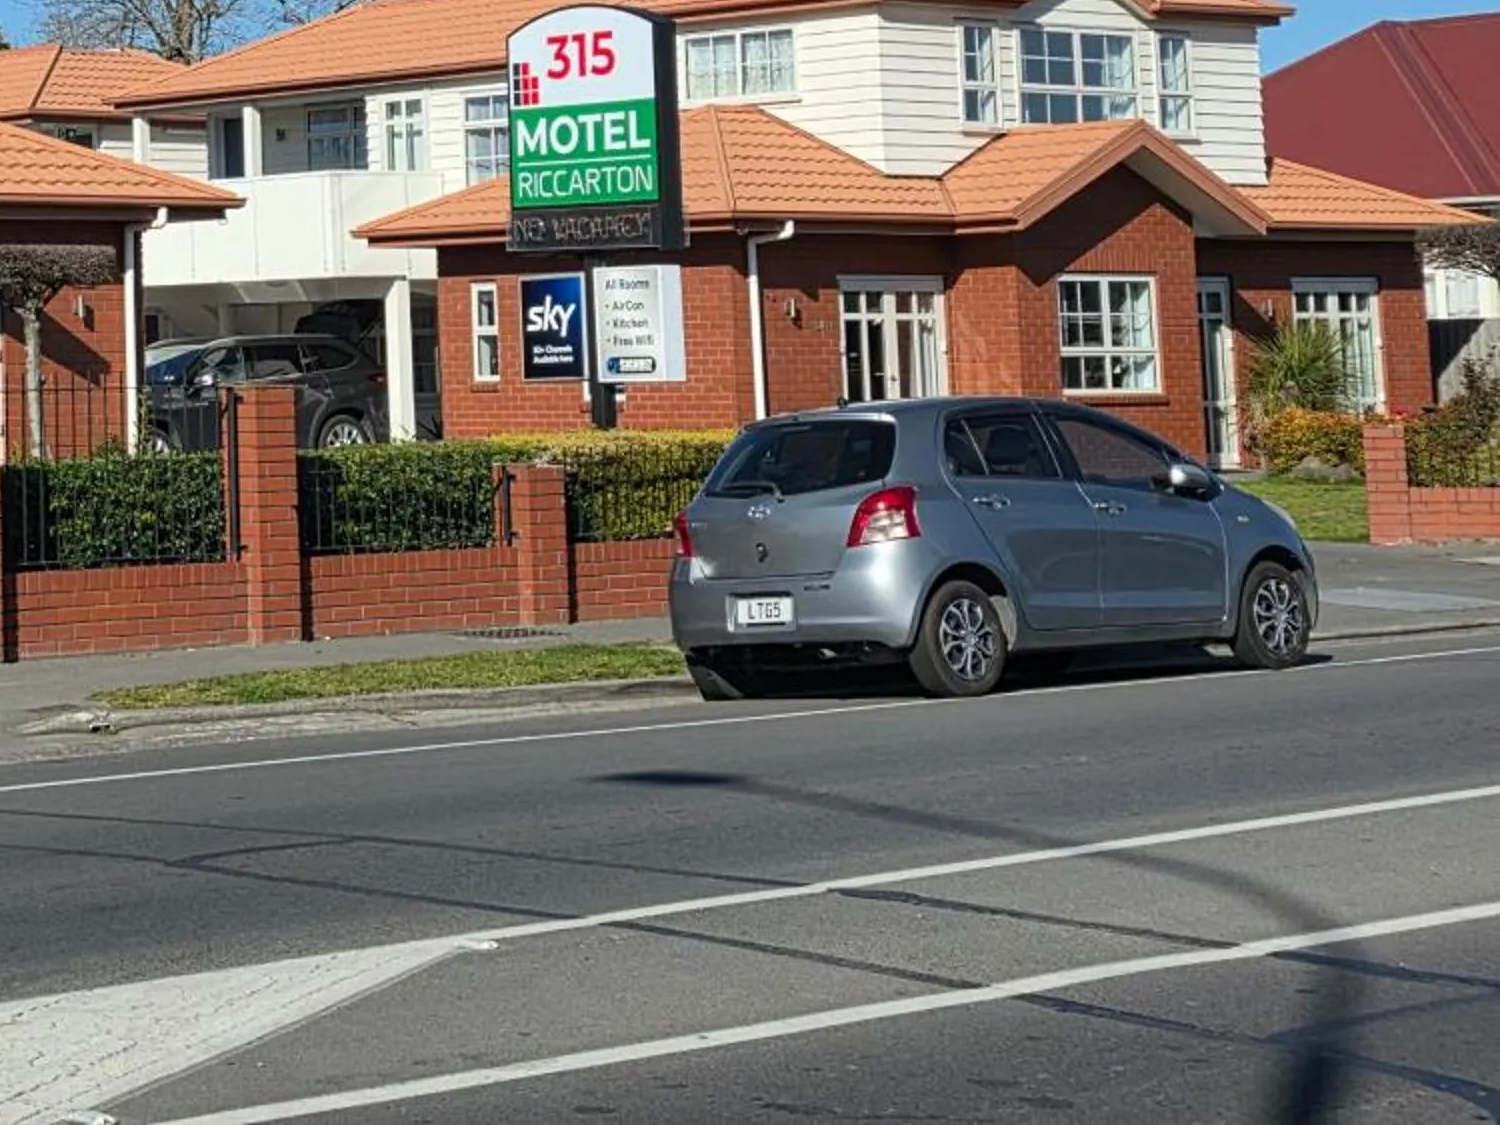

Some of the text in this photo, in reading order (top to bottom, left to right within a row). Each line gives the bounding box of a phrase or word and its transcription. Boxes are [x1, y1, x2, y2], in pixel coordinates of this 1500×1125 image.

[546, 30, 616, 79] 315
[516, 111, 651, 156] MOTEL
[519, 165, 653, 198] RICCARTON
[526, 294, 576, 338] sky
